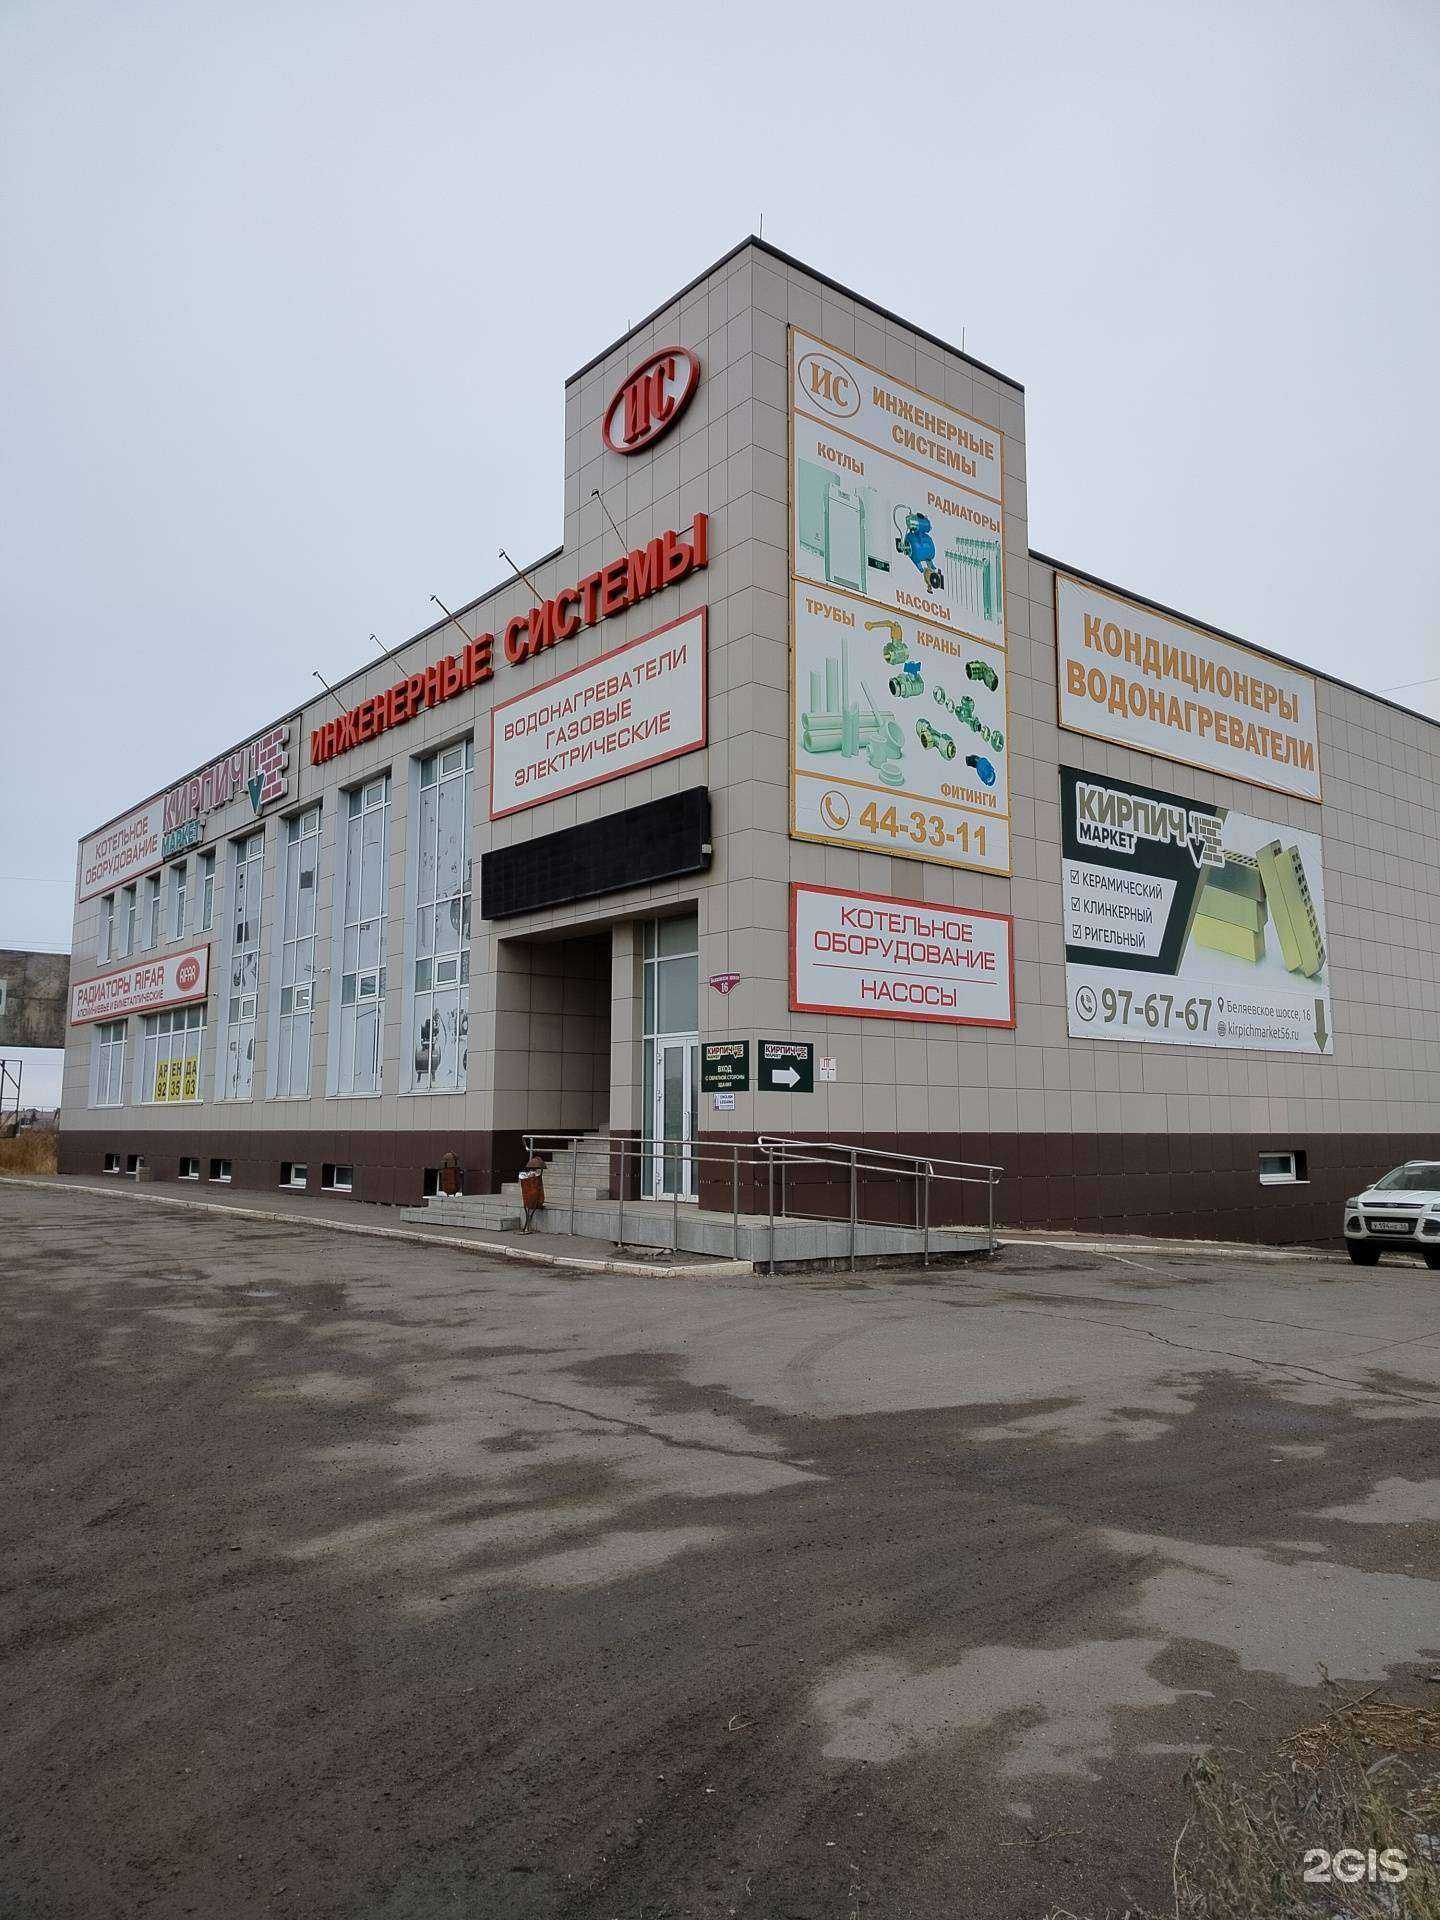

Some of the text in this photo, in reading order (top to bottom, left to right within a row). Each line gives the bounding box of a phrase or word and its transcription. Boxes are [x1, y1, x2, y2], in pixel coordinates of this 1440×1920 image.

[622, 358, 676, 445] ИС
[810, 361, 849, 408] ИС
[872, 385, 995, 461] ИНЖЕНЕРНЫЕ
[817, 441, 865, 476] КОТЛЫ
[891, 424, 977, 478] СИСТЕМЫ
[927, 491, 1000, 533] РАДИАТОРЫ
[805, 598, 856, 627] ТРУБЫ
[895, 590, 951, 621] НАСОСЫ
[310, 512, 710, 766] ИНЖЕНЕРНЫЕ СИСТЕМЫ
[917, 630, 962, 658] КРАНЫ
[1083, 612, 1299, 723] КОНДИЦИОНЕРЫ
[504, 643, 688, 742] ВОДОНАГРЕВАТЕЛИ
[546, 698, 633, 750] ГАЗОВЫЕ
[1066, 658, 1315, 772] ВОДОНАГРЕВАТЕЛИ
[514, 709, 671, 788] ЭЛЕКТРИЧЕСКИЕ
[162, 746, 248, 835] КИРПИЧ
[940, 783, 997, 808] ФИТИНГИ
[859, 801, 986, 857] 44-33-11
[1078, 786, 1186, 843] КИРПИЧ
[95, 816, 149, 860] КОТЕЛЬНОЕ
[162, 819, 202, 858] МАРКЕТ
[1079, 822, 1134, 850] МАРКЕТ
[86, 834, 158, 885] ОБОРУДОВАНИЕ
[1082, 872, 1163, 900] КЕРАМИЧЕСКИЙ
[841, 906, 973, 943] КОТЕЛЬНОЕ
[1083, 899, 1153, 924] КЛИНКЕРНЫЙ
[814, 930, 995, 971] ОБОРУДОВАНИЕ
[1084, 926, 1146, 949] РИГЕЛЬНЫЙ
[77, 966, 165, 1007] РАДИАТОРЫ RIFAR
[721, 982, 729, 993] 16
[861, 979, 957, 1007] НАСОСЫ
[1101, 987, 1212, 1032] 97-67-67
[1226, 1000, 1275, 1018] Беляевское
[1302, 1008, 1312, 1021] 16
[707, 1046, 733, 1055] КИРПИЧ
[765, 1044, 796, 1054] КИРПИЧ
[1227, 1021, 1299, 1041] kirpichmarket56.ru
[717, 1065, 732, 1073] ВХОД
